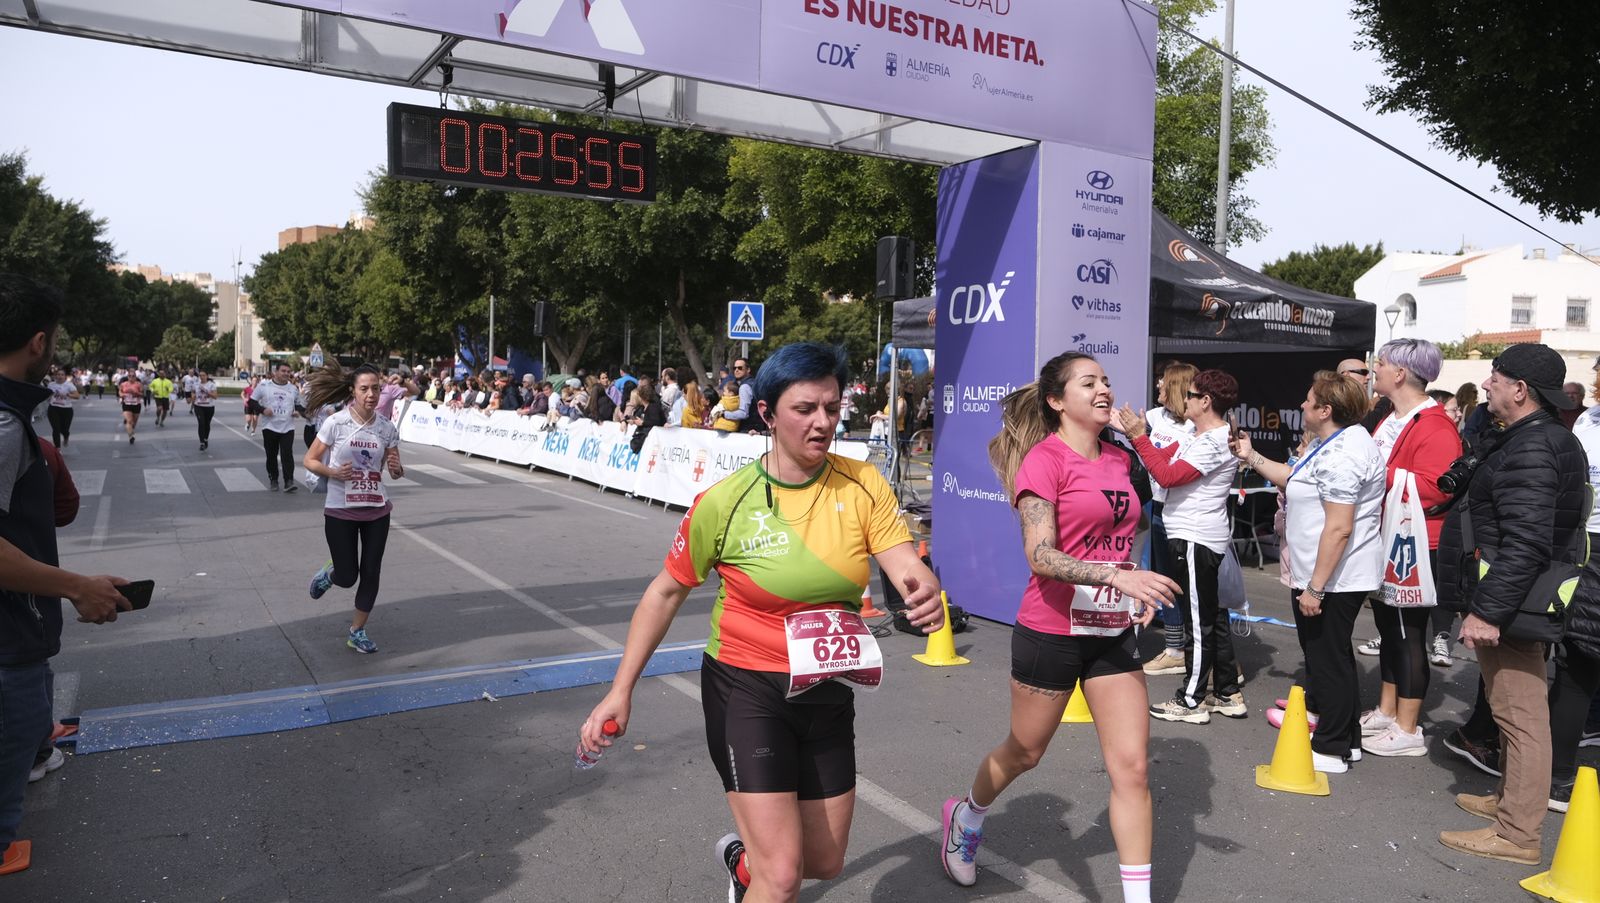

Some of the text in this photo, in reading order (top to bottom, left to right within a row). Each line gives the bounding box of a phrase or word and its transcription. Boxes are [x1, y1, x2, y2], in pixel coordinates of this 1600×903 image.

[847, 0, 969, 50] NUESTRA
[973, 28, 1045, 67] META.
[816, 42, 861, 70] CDX
[906, 58, 951, 78] ALMERÍA
[905, 71, 930, 82] CIUDAD
[440, 118, 644, 192] 00:25:55
[1075, 189, 1124, 206] HYUNDAI
[1087, 227, 1126, 241] cajamar
[1076, 263, 1111, 285] CASI
[949, 271, 1016, 325] CDX
[1087, 298, 1122, 313] vithas
[1078, 341, 1119, 355] aqualia
[962, 402, 990, 413] CIUDAD
[350, 440, 378, 449] MUJER
[1152, 432, 1173, 443] MUJER
[351, 480, 379, 491] 2533
[1084, 535, 1134, 552] VIRUS
[1092, 584, 1123, 604] 719
[1395, 589, 1423, 603] CASH
[801, 622, 824, 630] MUJER
[813, 635, 861, 663] 629
[819, 659, 861, 669] MYROSLAVA
